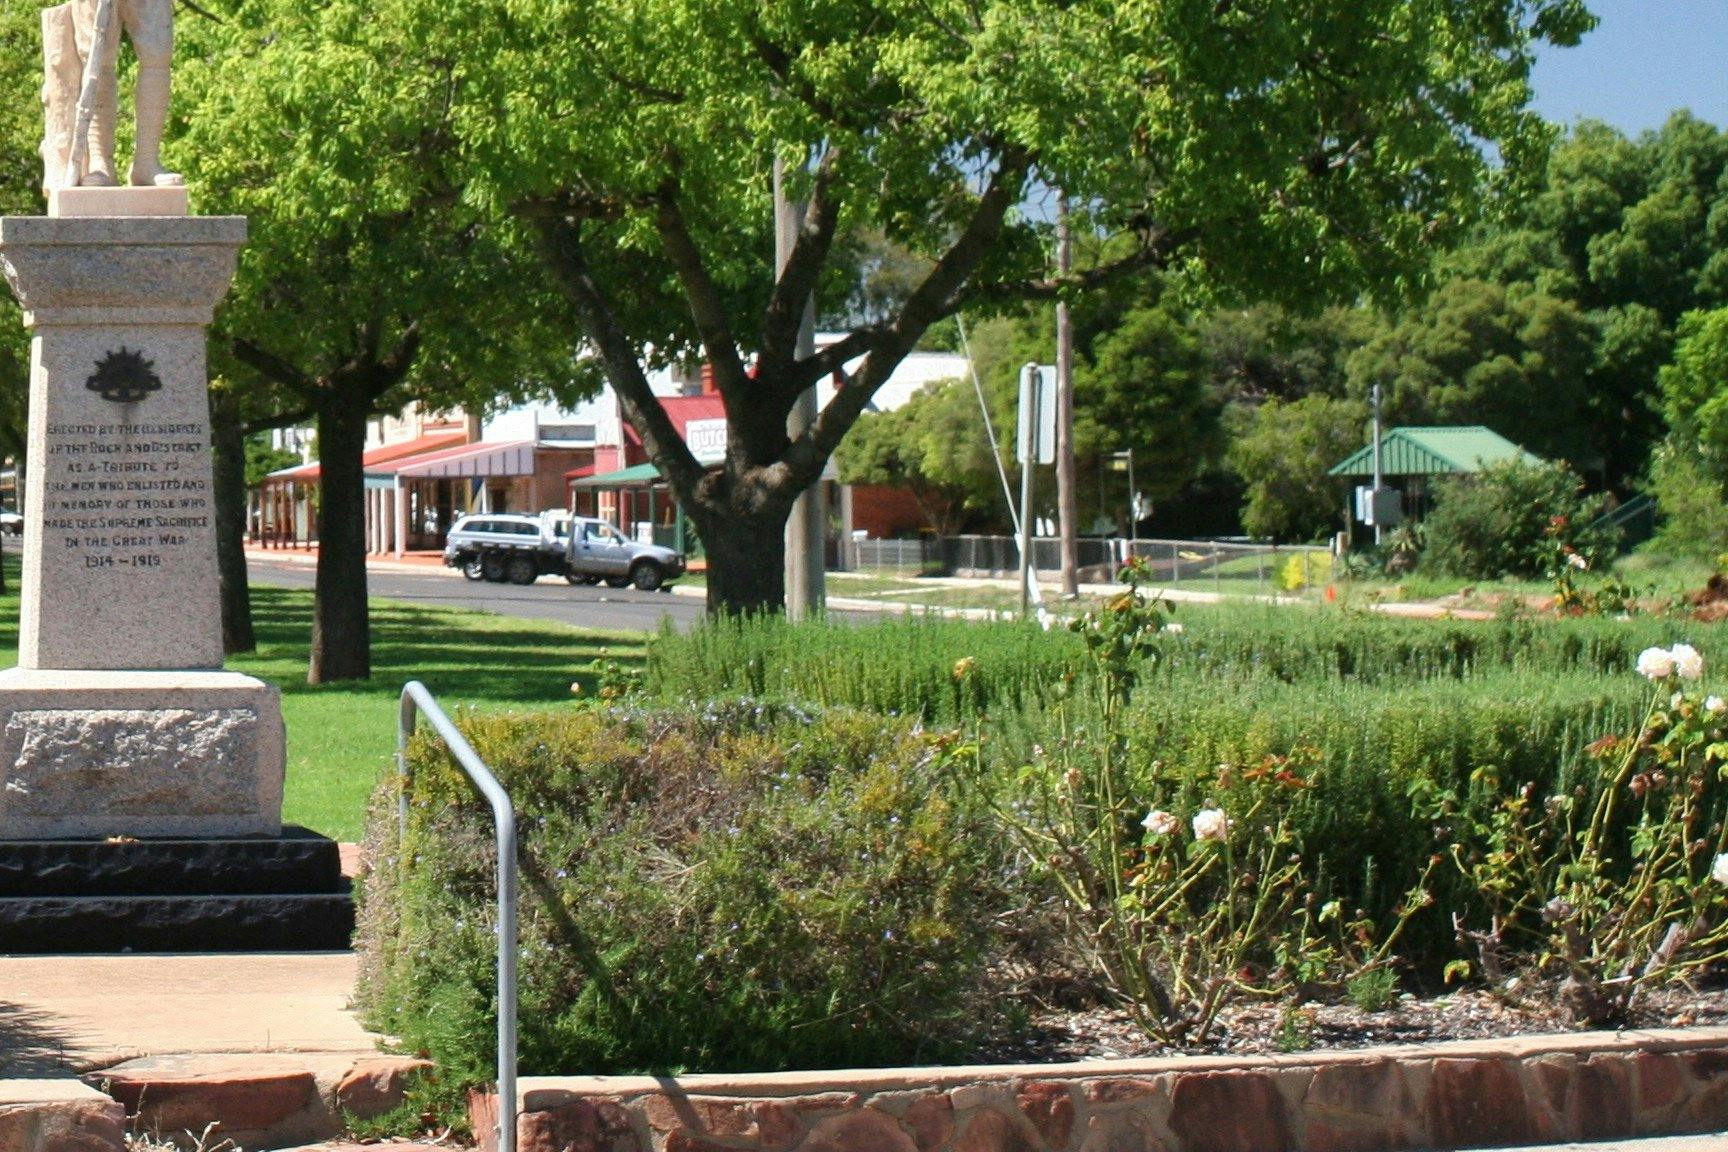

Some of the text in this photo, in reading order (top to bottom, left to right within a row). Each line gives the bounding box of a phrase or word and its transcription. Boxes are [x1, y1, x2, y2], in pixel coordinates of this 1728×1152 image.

[118, 424, 139, 434] THE
[65, 443, 87, 454] THE
[89, 441, 122, 454] ROCK
[125, 442, 150, 454] AND
[151, 441, 203, 454] DISTRICT
[67, 462, 83, 473] AS
[101, 460, 158, 473] TRIBUTE
[164, 461, 180, 472] TO
[71, 481, 95, 491] MEN
[98, 481, 124, 491] WHO
[127, 480, 181, 491] ENLISTED
[181, 479, 206, 491] AND
[61, 499, 112, 510] MEMORY
[116, 499, 131, 510] OF
[136, 499, 176, 510] THOSE
[179, 498, 206, 509] WHO
[43, 515, 208, 529] MADE THE SUPREME SACRIFICE
[64, 534, 186, 548] IN THE GREAT WAR
[85, 555, 115, 568] 1914
